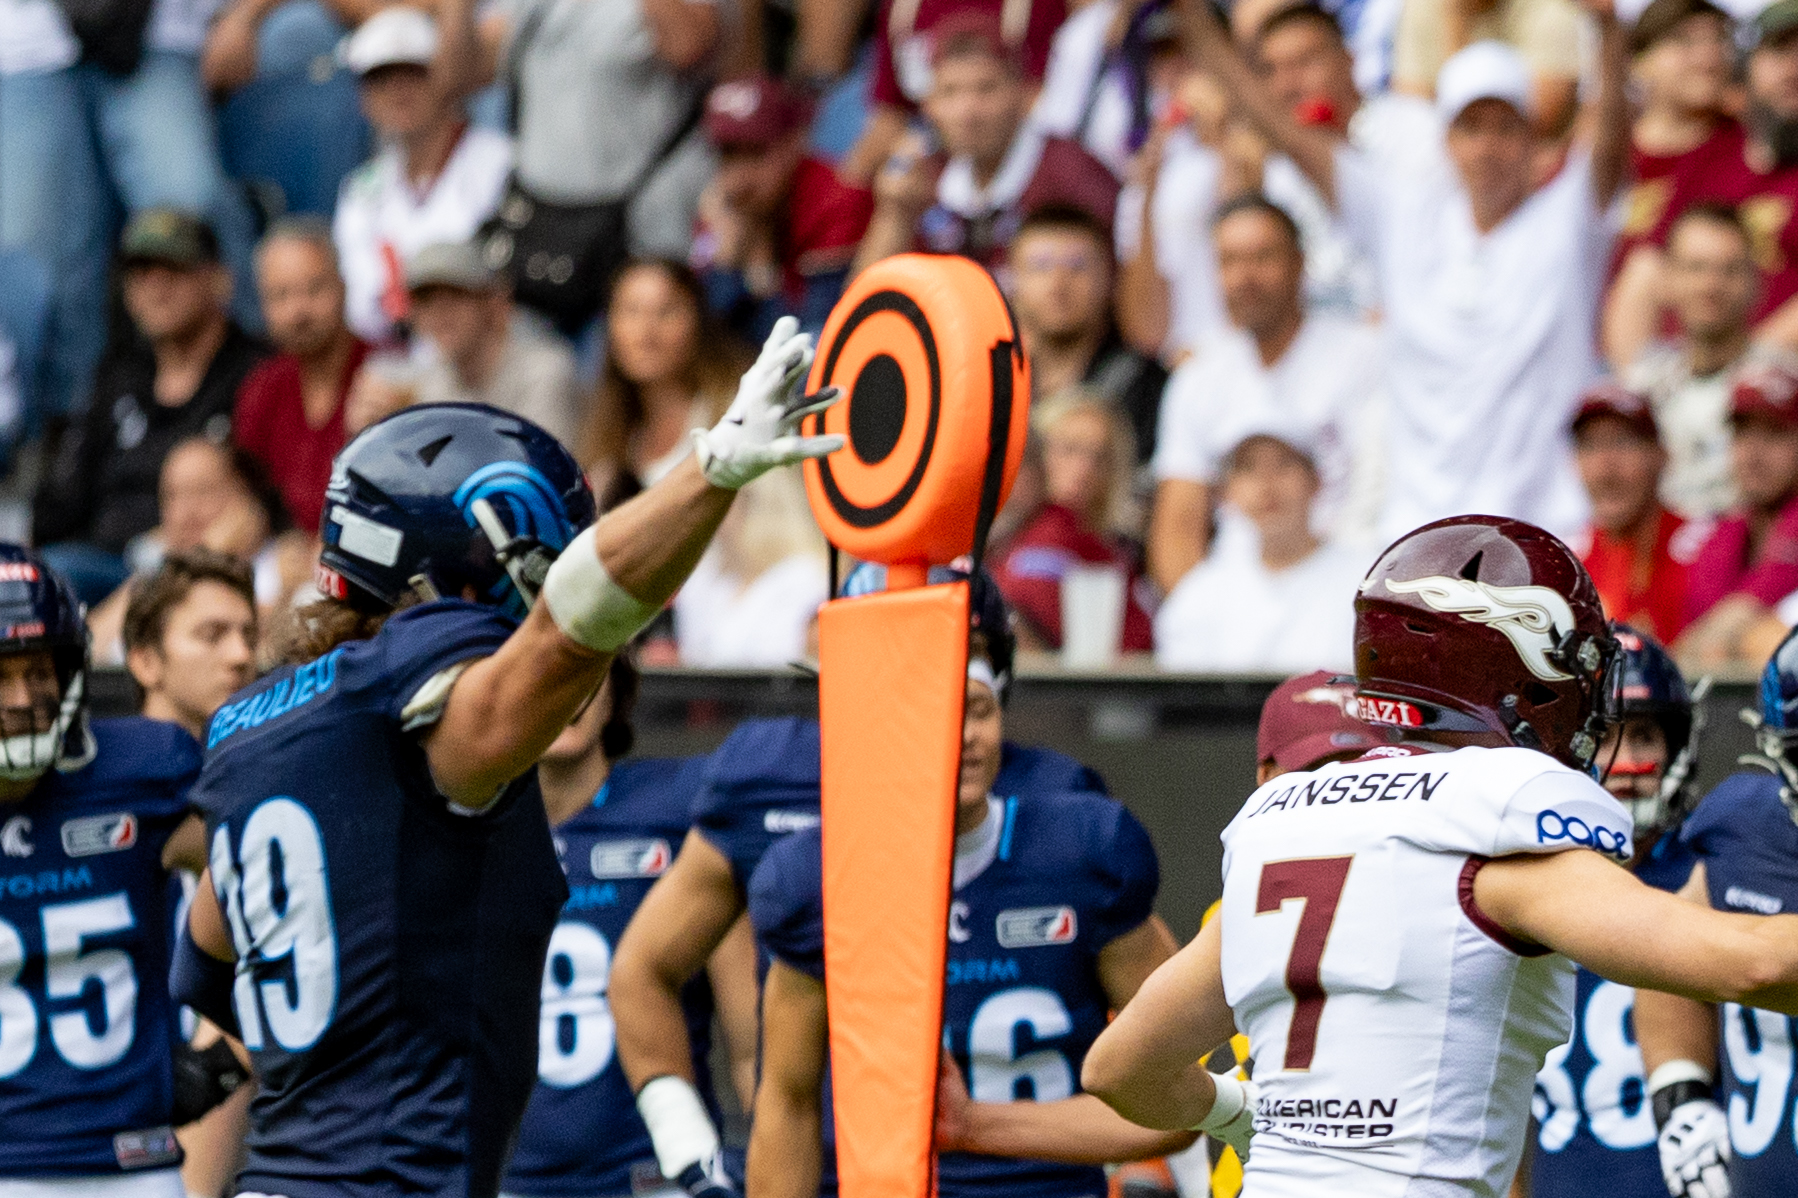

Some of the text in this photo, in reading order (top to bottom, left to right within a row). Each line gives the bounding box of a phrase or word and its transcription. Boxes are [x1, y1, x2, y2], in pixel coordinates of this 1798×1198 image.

[1248, 772, 1449, 818] JANSSEN
[210, 798, 340, 1052] 19
[1253, 853, 1356, 1073] 7
